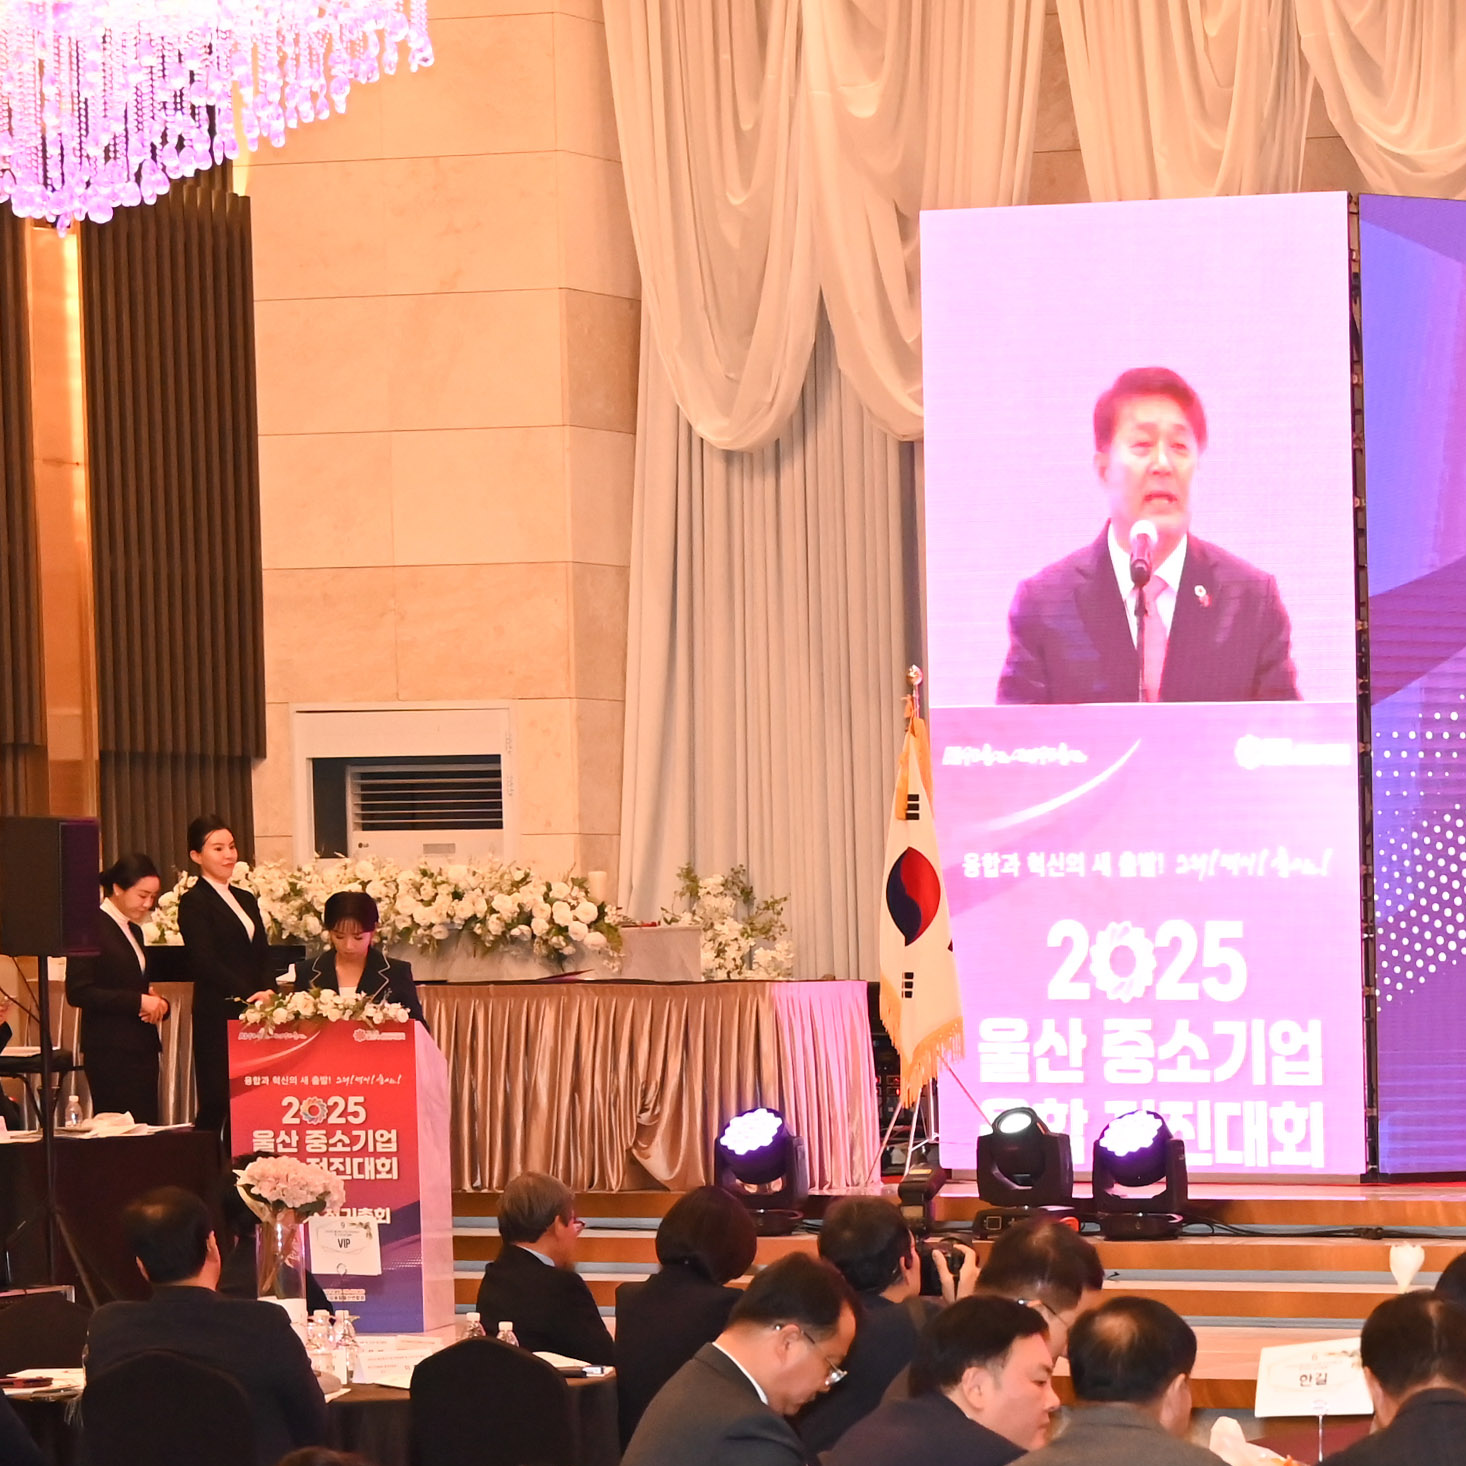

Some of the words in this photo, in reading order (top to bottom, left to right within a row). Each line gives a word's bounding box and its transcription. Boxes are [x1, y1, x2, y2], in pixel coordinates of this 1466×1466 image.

[962, 851, 1021, 878] 융합과
[1027, 851, 1085, 878] 혁신의
[1092, 850, 1112, 878] 새
[1118, 850, 1165, 878] 출발!
[1047, 919, 1248, 1004] 2025
[978, 1017, 1088, 1084] 울산
[1101, 1018, 1324, 1087] 중소기업
[244, 1075, 270, 1086] 융합과
[272, 1075, 298, 1086] 혁신의
[300, 1075, 309, 1086] 새
[281, 1095, 367, 1126] 2025
[252, 1129, 299, 1153] 울산
[305, 1129, 398, 1153] 중소기업
[338, 1238, 351, 1249] VIP
